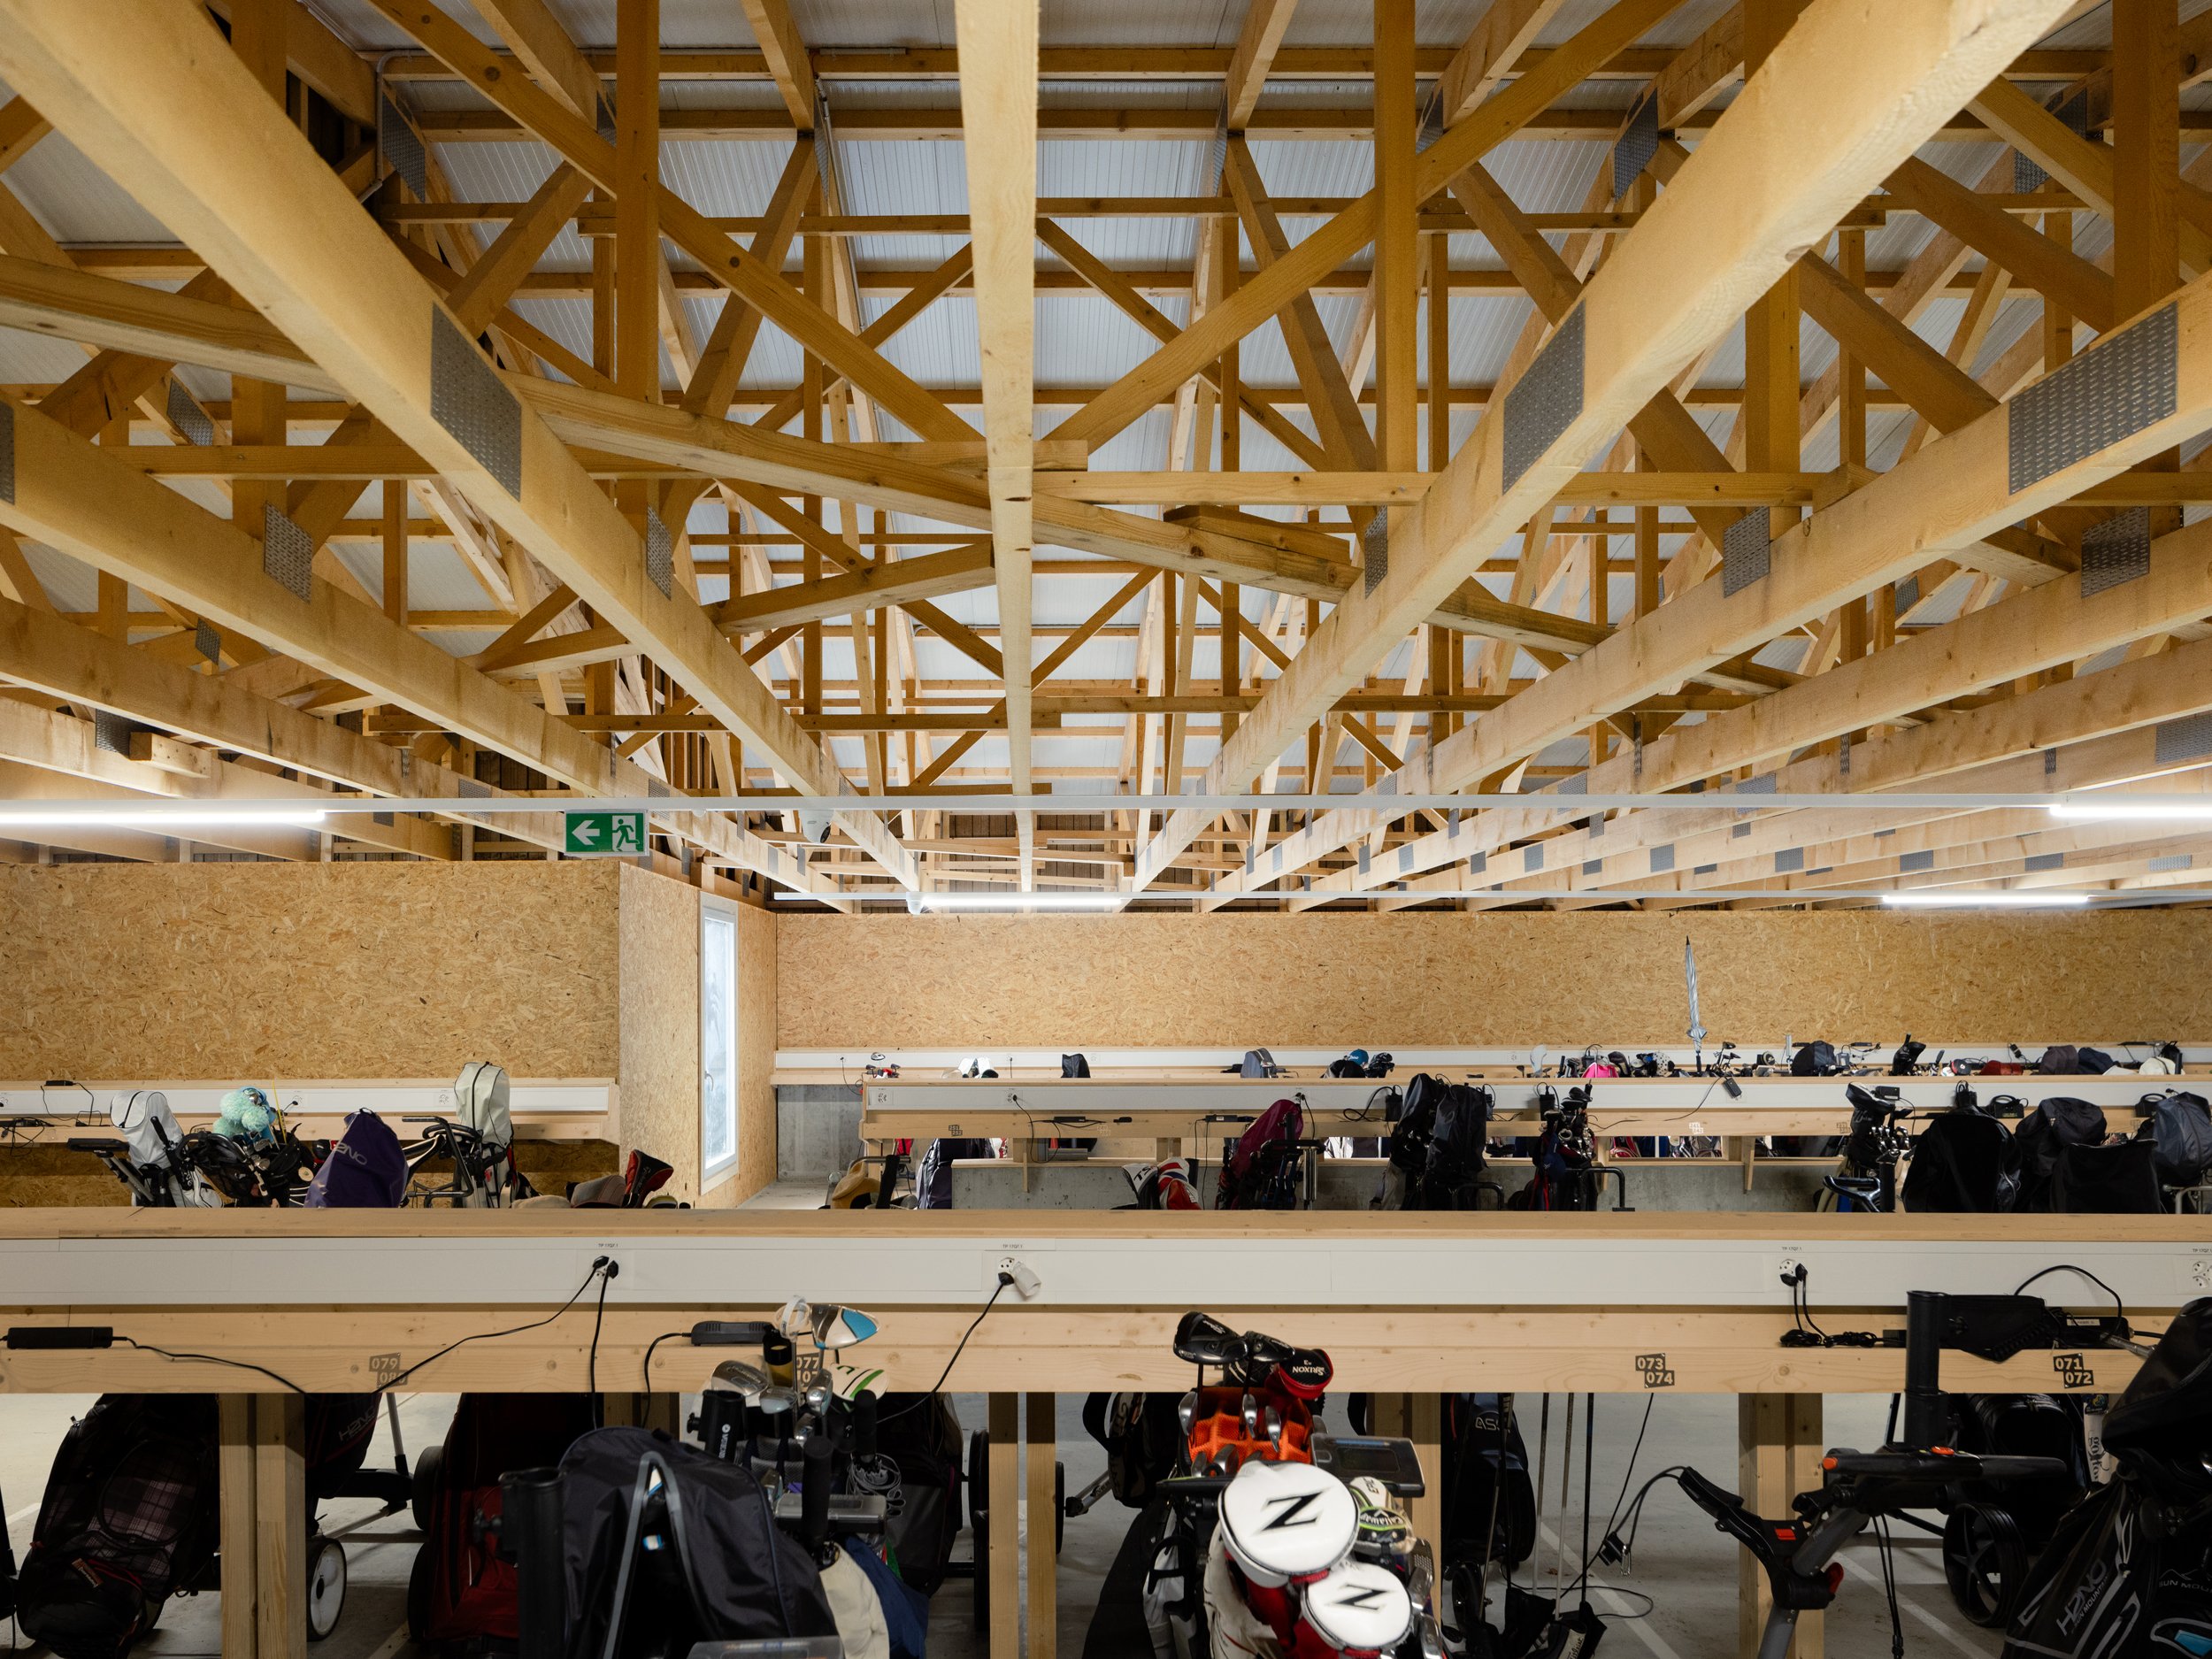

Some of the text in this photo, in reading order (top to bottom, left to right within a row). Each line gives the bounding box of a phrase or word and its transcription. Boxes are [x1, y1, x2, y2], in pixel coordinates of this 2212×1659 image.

[335, 1142, 368, 1165] 2NO
[372, 1357, 398, 1370] 079
[1292, 1365, 1325, 1376] SRIXON
[1637, 1357, 1663, 1371] 073
[2055, 1357, 2083, 1371] 071
[1646, 1371, 1673, 1385] 074
[2064, 1371, 2093, 1384] 072
[1255, 1488, 1329, 1534] Z
[2159, 1578, 2179, 1588] SUN
[2055, 1557, 2108, 1637] H2NO
